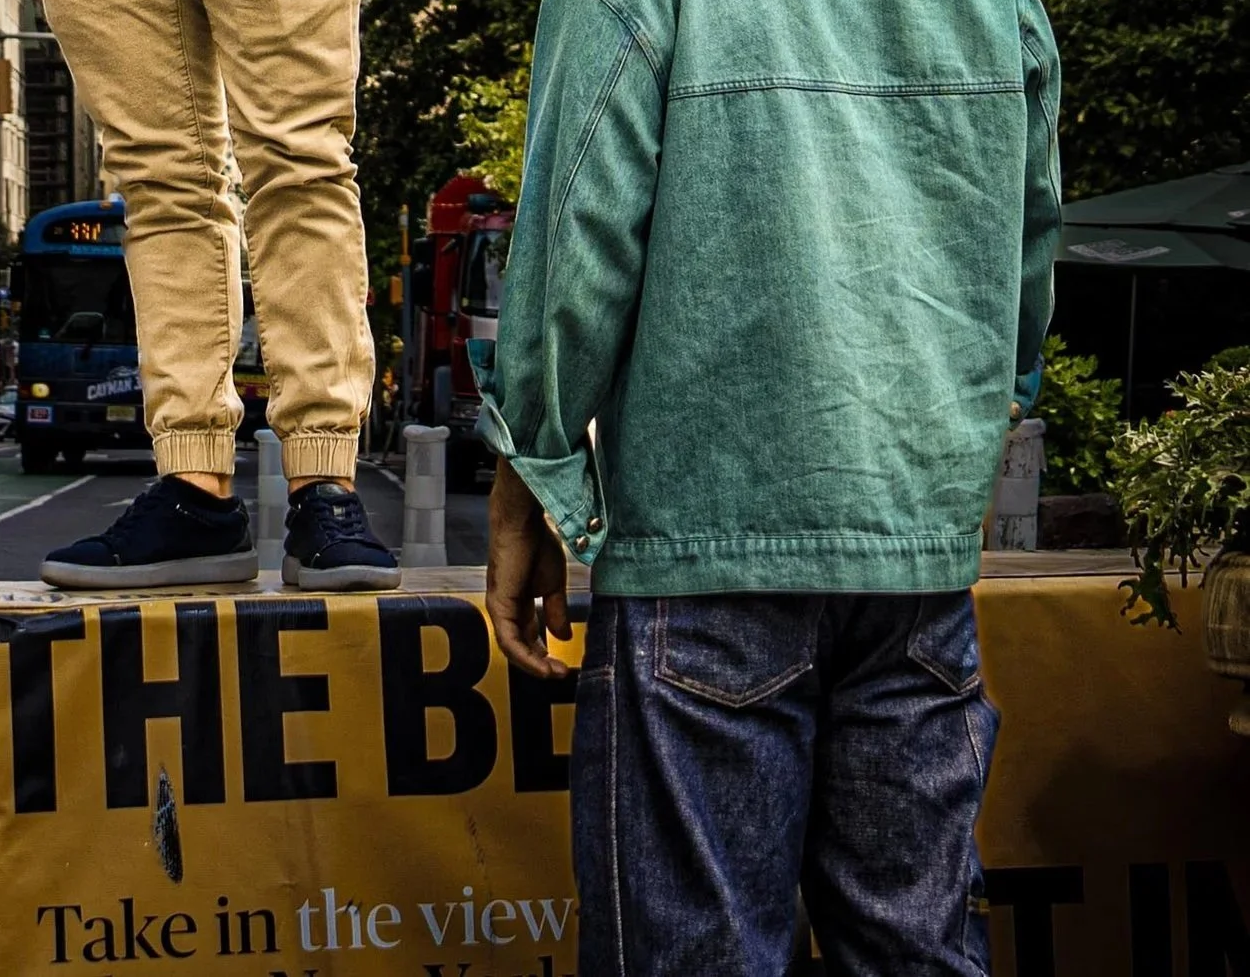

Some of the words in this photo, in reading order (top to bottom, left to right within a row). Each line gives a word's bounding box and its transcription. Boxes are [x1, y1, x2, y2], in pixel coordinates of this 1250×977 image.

[37, 897, 197, 964] Take
[215, 895, 281, 956] in
[295, 887, 402, 952] the
[416, 885, 575, 948] view
